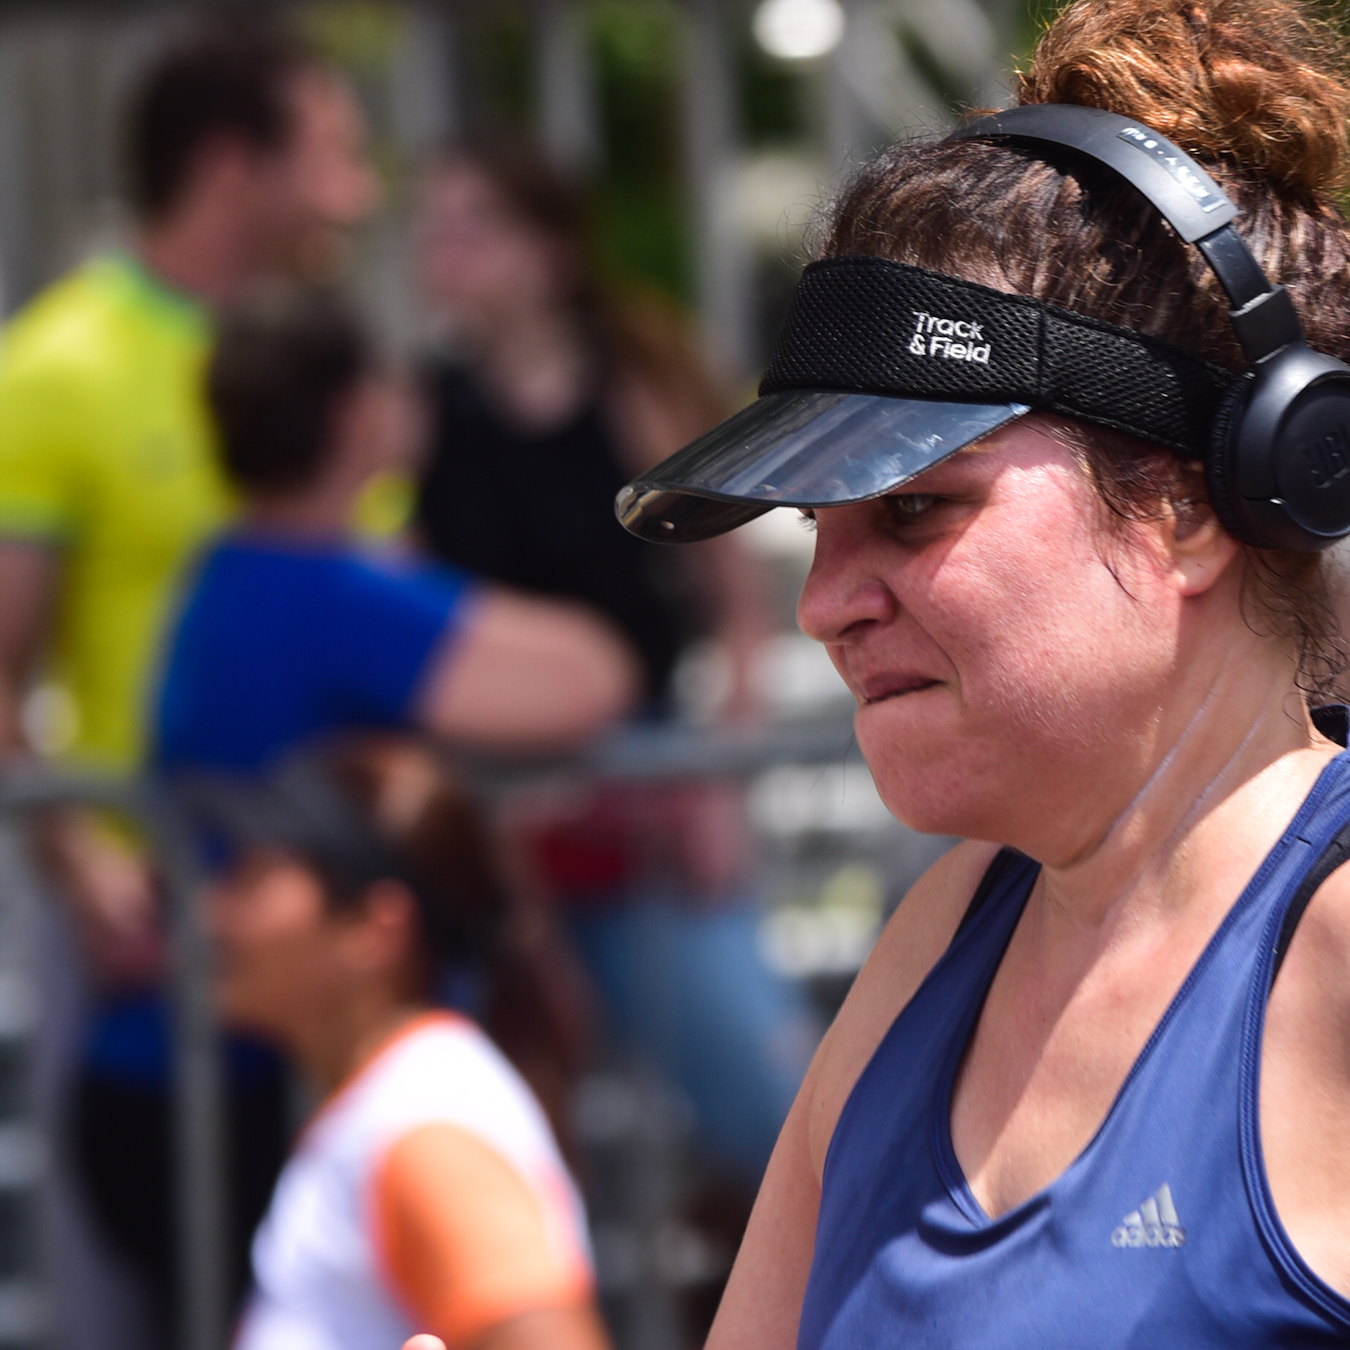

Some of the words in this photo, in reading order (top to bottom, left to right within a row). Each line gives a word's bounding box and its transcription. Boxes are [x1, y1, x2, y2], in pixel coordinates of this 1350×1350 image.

[912, 310, 984, 341] Track
[909, 333, 926, 356] &
[930, 336, 991, 364] Field
